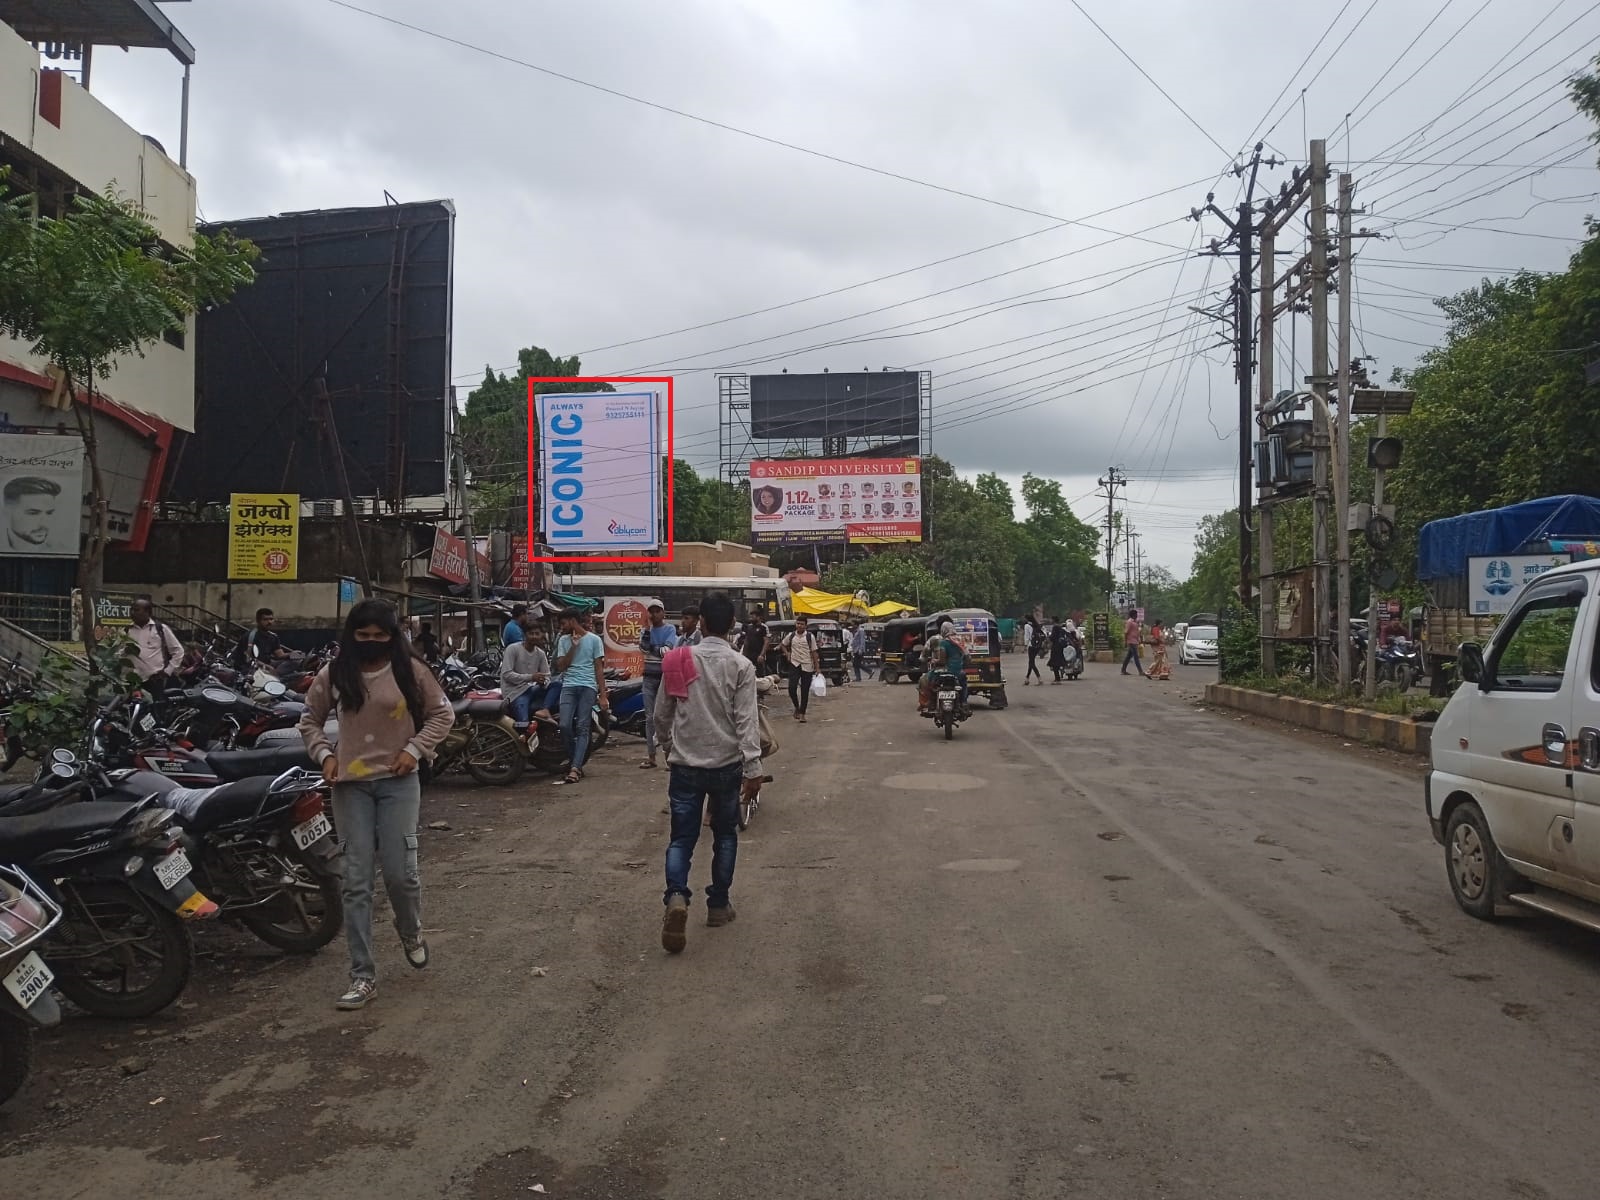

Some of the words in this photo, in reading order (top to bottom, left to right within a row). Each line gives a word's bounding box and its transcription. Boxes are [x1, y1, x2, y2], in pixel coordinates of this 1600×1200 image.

[551, 403, 583, 411] ALWAYS
[551, 414, 583, 538] ICONIC
[768, 465, 815, 476] SANDIP
[820, 463, 903, 475] UNIVERSITY
[237, 498, 292, 520] जम्बो
[234, 520, 293, 538] झेरॉक्स
[270, 553, 284, 565] 50
[96, 597, 120, 618] हॉटेल
[301, 820, 327, 846] 0057
[20, 970, 50, 1004] 2904
